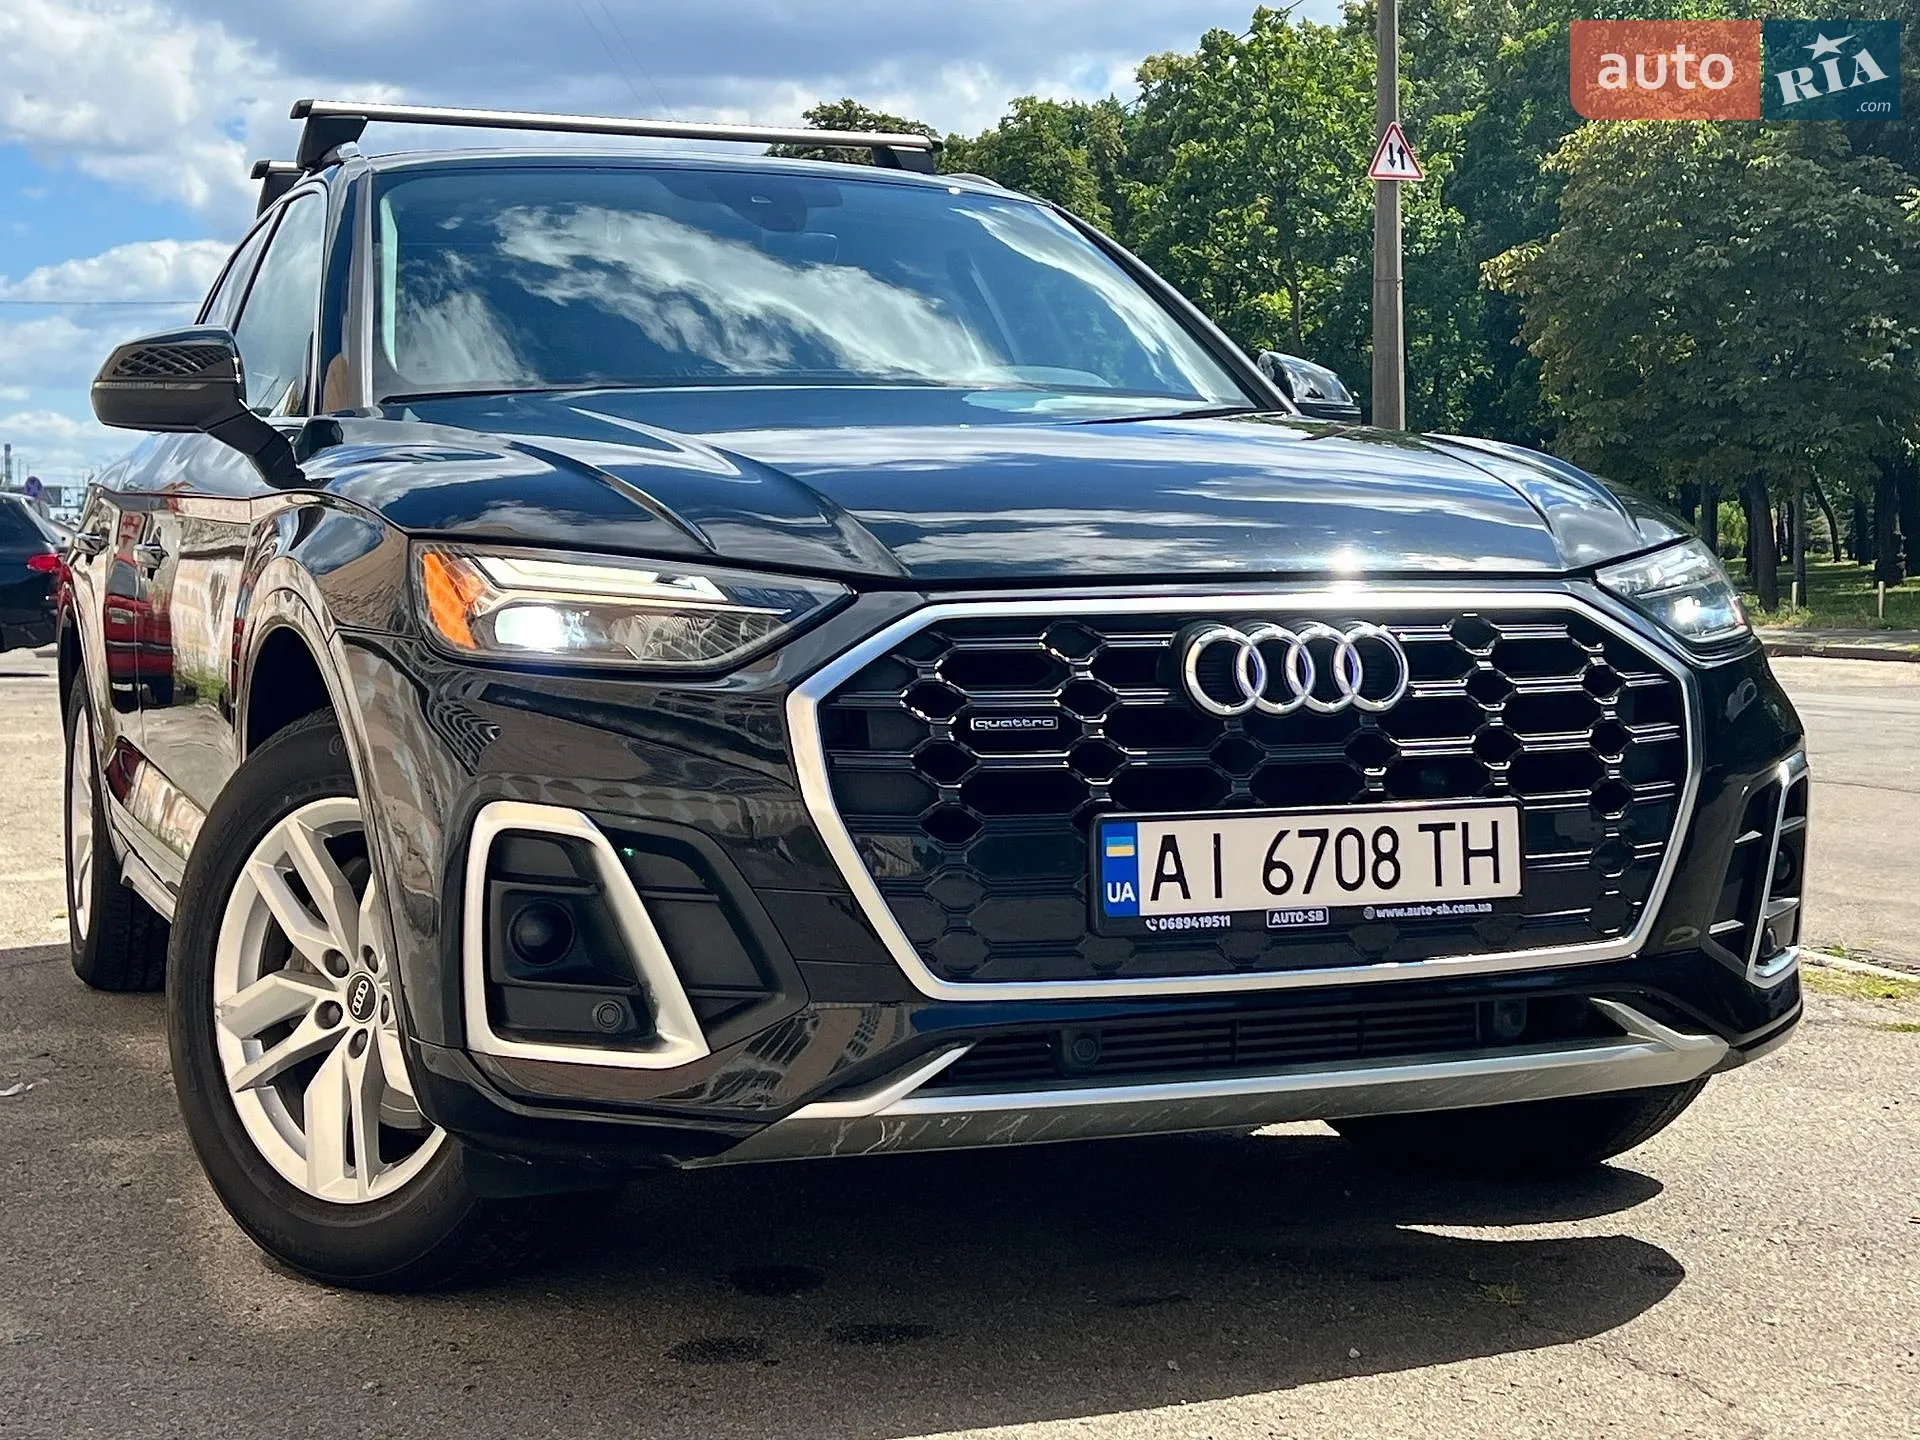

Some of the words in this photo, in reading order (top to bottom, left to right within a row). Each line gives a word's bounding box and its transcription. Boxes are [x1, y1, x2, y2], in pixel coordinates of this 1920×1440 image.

[975, 718, 1055, 730] quattro
[1150, 832, 1222, 902] AI
[1262, 825, 1402, 896] 6708
[1418, 820, 1501, 888] TH
[1107, 882, 1136, 903] UA
[1271, 910, 1325, 924] AUTO-SB
[1376, 903, 1493, 919] www.auto-sb.com.ua
[1159, 914, 1231, 930] 0689419511
